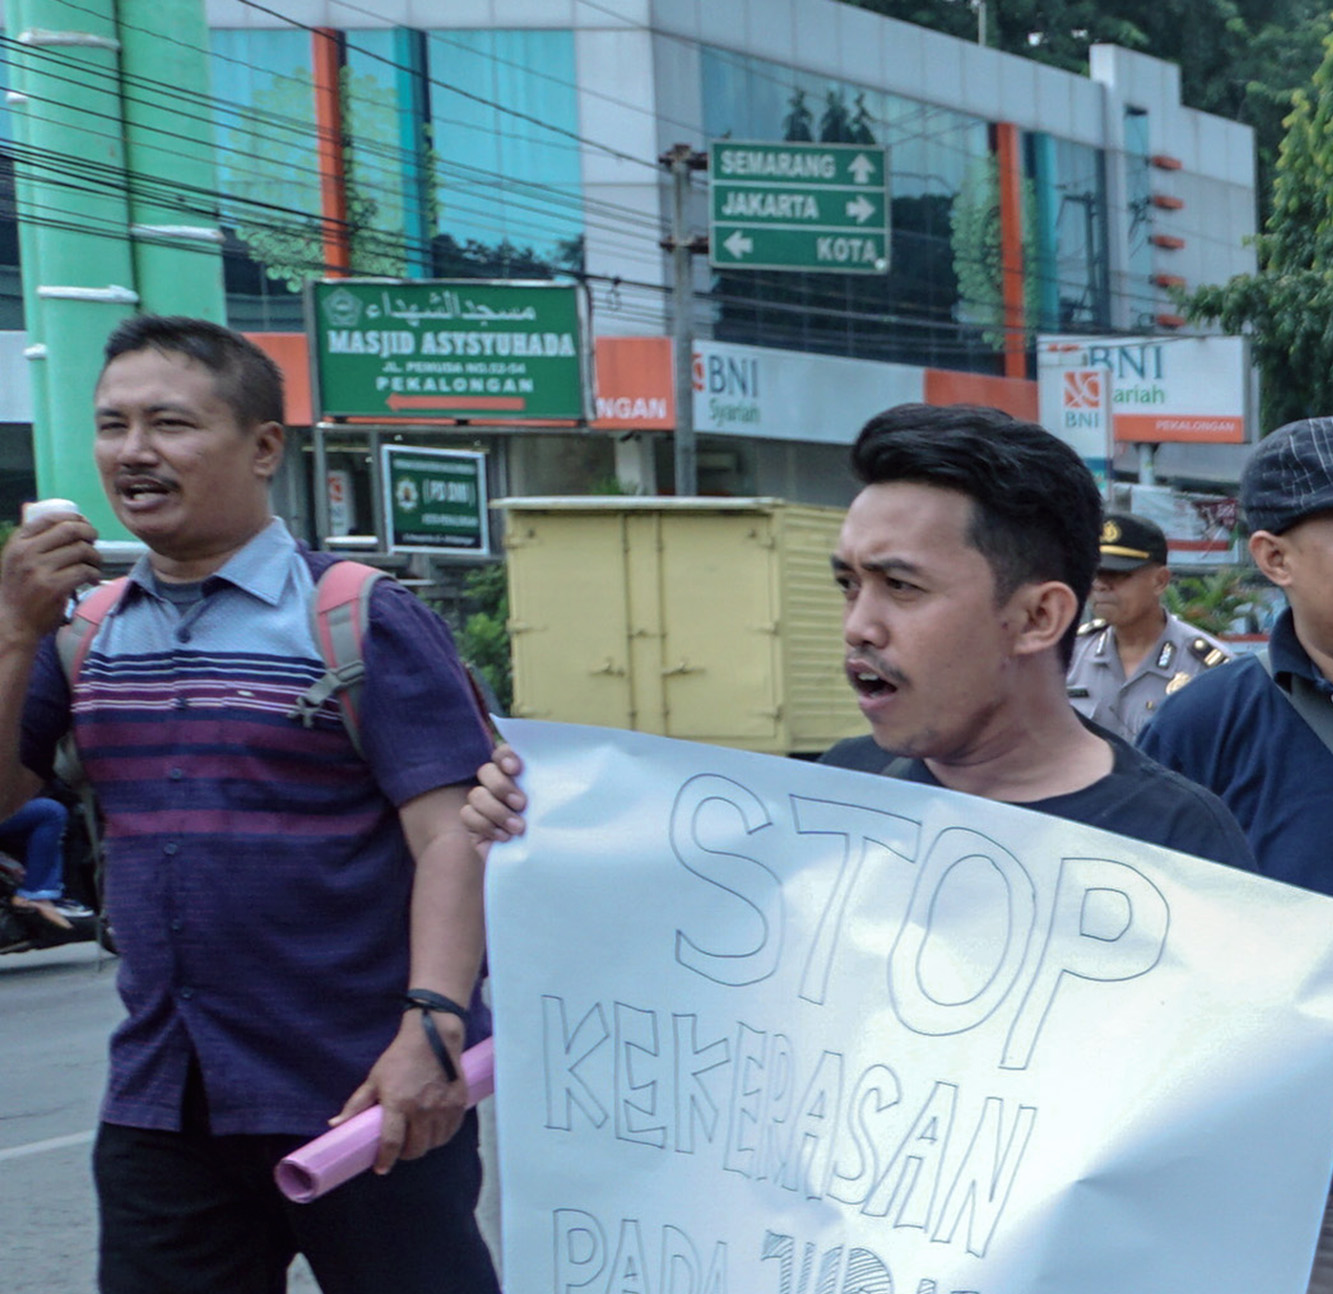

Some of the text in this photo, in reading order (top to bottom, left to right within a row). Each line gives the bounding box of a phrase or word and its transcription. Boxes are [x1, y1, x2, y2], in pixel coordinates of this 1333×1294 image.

[721, 151, 836, 179] SEMARANG
[722, 192, 820, 219] JAKARTA
[817, 237, 877, 262] KOTA
[327, 330, 575, 358] MASJID ASYSYUHADA
[1089, 345, 1163, 379] BNI
[376, 376, 534, 392] PEKALONGAN
[708, 355, 759, 398] BNI
[708, 399, 761, 427] Syariah
[1065, 411, 1099, 429] BNI
[1155, 420, 1235, 432] PEKALONGAN
[668, 772, 1170, 1071] STOP
[541, 994, 1037, 1258] KEKERASAN
